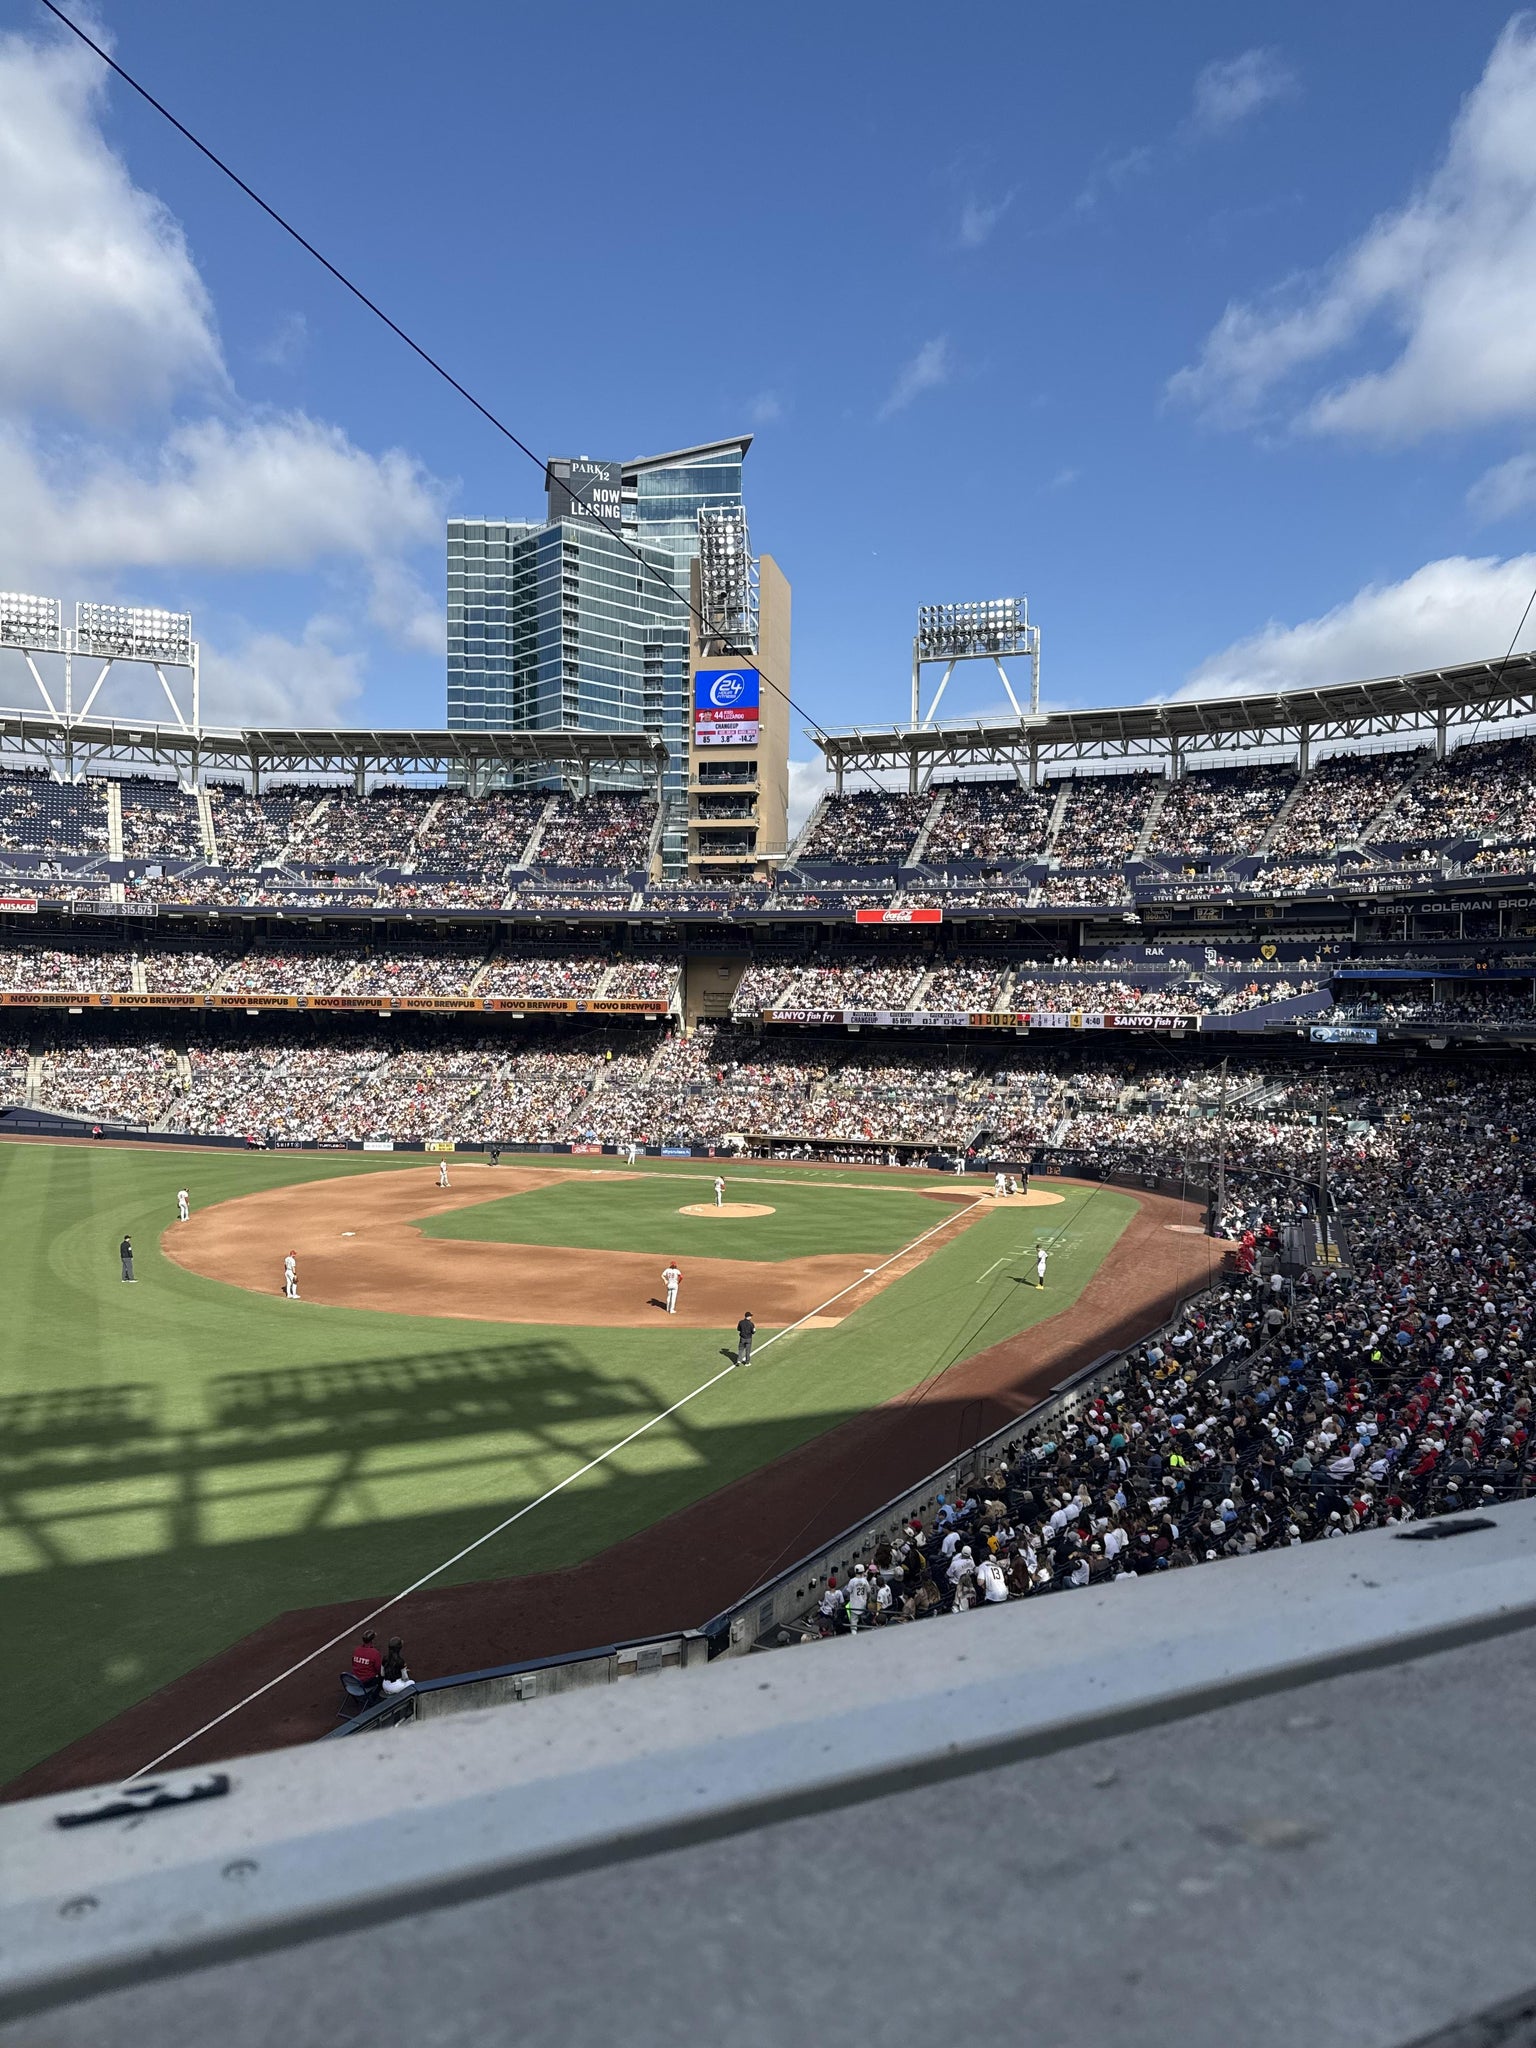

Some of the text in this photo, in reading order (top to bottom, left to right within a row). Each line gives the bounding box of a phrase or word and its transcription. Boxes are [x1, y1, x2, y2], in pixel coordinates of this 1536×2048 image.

[572, 463, 602, 475] PARK
[599, 472, 610, 481] 12
[593, 488, 620, 503] NOW
[571, 502, 620, 519] LEASING
[719, 679, 742, 694] 24
[714, 711, 723, 720] 44
[121, 904, 153, 915] $15,675
[1369, 905, 1415, 915] JERRY
[1421, 901, 1492, 913] COLEMAN
[1145, 947, 1165, 956] RAK
[10, 995, 40, 1003] NOVO
[221, 997, 246, 1005] NOVO
[314, 998, 340, 1006] NOVO
[772, 1011, 806, 1020] SANYO
[806, 1011, 821, 1022] fish
[822, 1011, 835, 1022] fry
[1010, 1014, 1016, 1025] 2
[1085, 1017, 1101, 1025] 4:40
[1113, 1016, 1188, 1028] SANYO fish fry
[990, 1567, 1001, 1580] 13
[856, 1587, 865, 1597] 23
